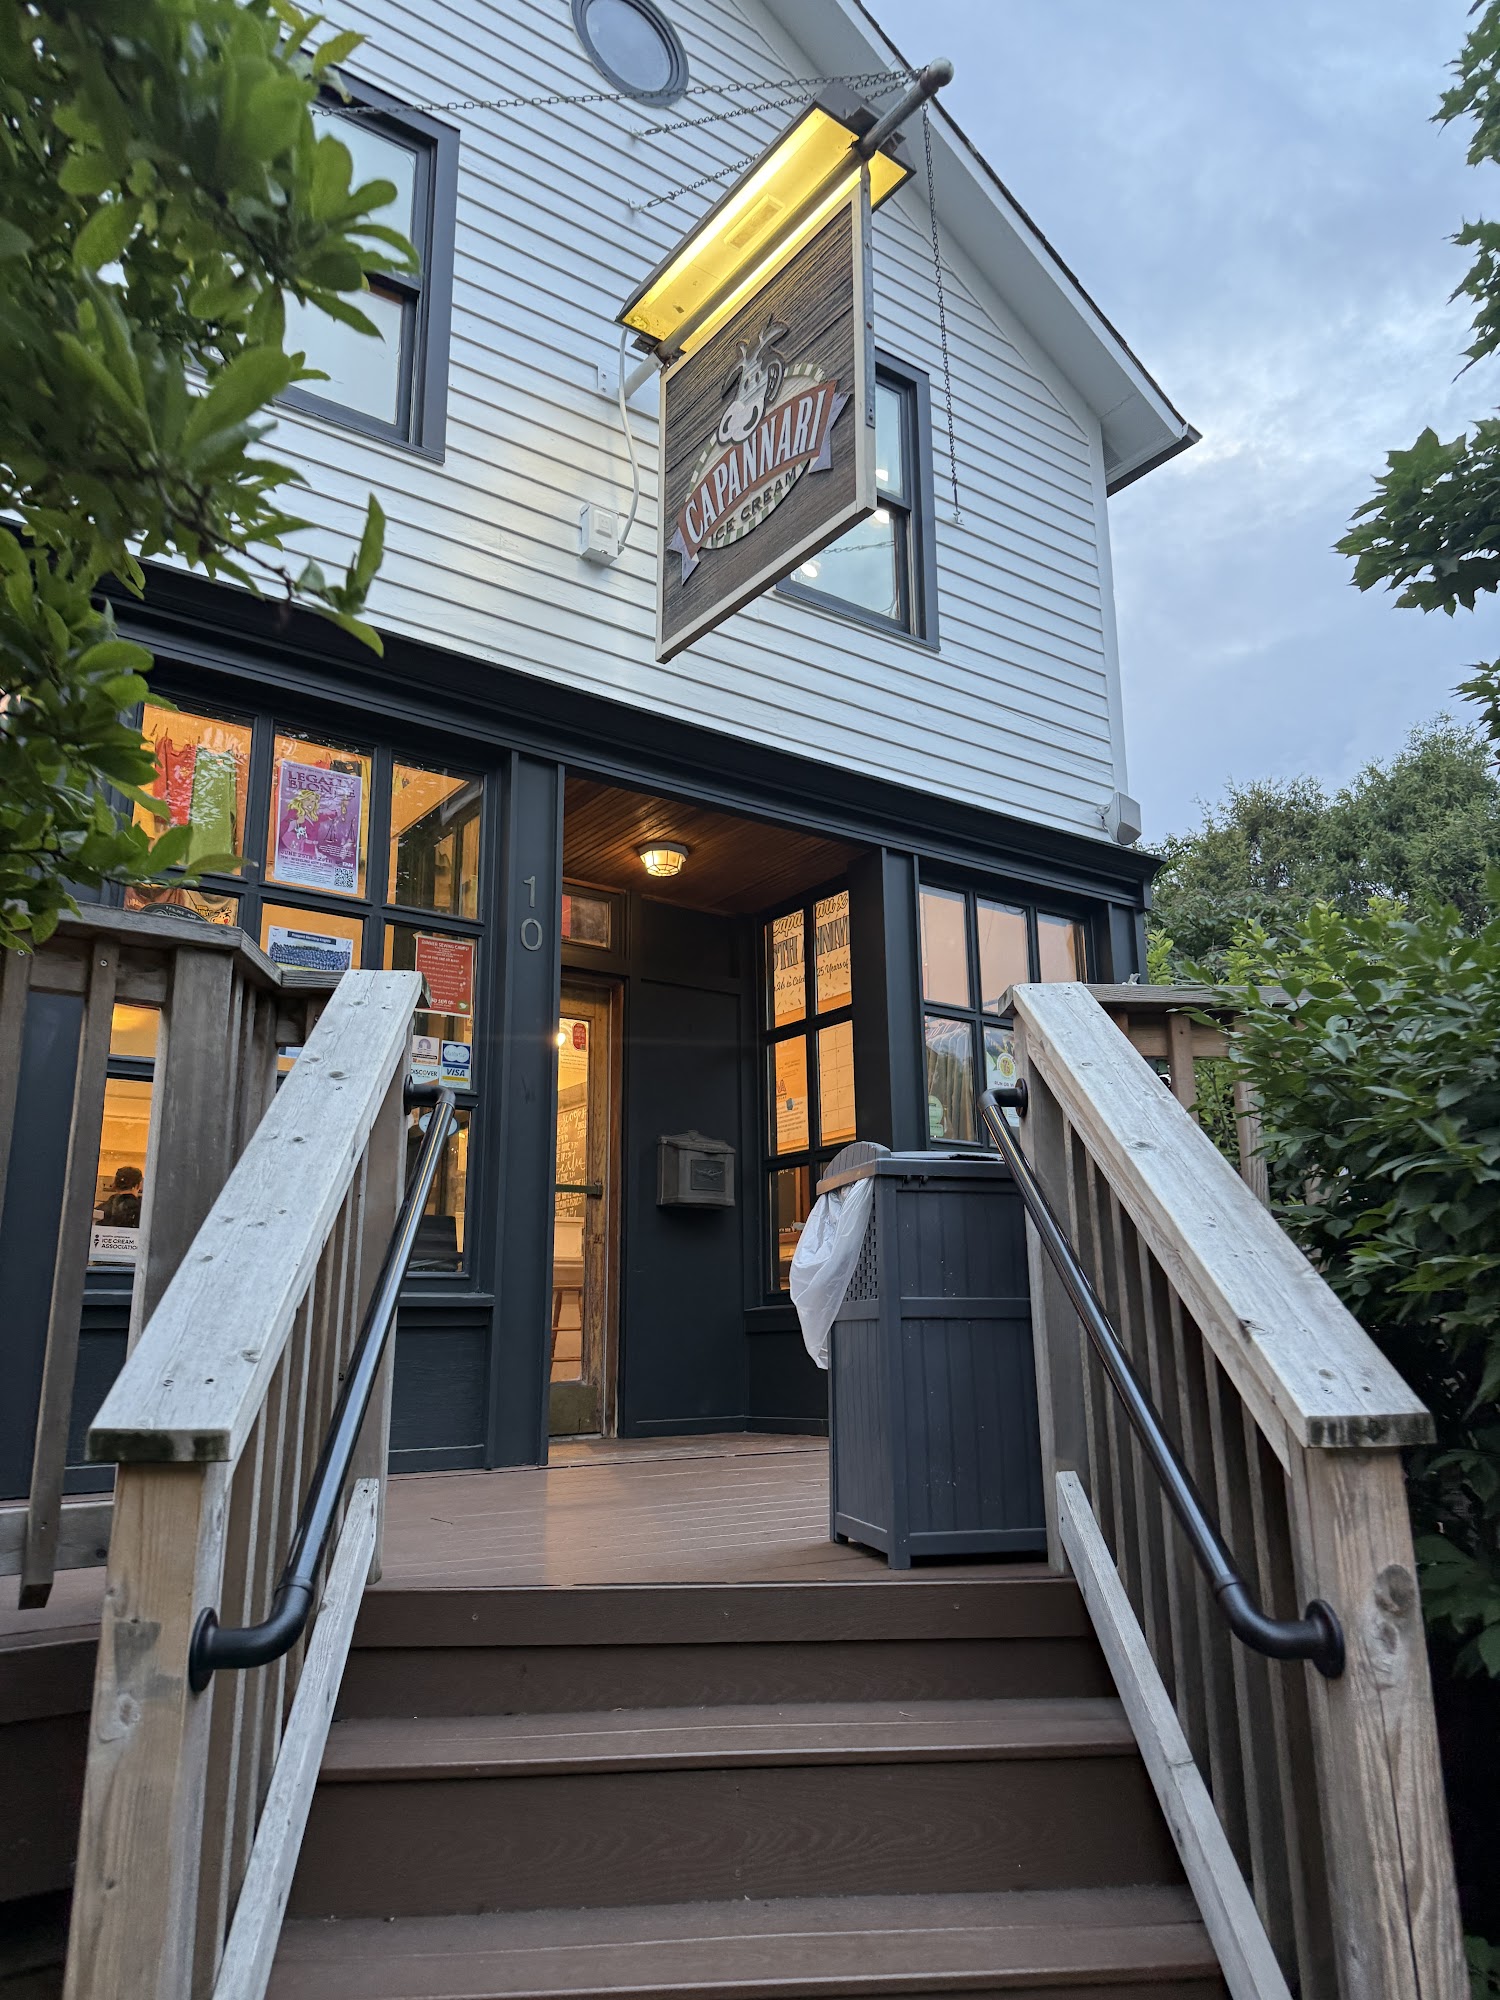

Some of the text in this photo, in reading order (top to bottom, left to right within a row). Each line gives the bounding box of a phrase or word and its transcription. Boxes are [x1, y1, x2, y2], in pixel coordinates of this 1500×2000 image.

[685, 389, 826, 543] CAPANNARI
[710, 466, 797, 547] ICE CREAM
[288, 771, 356, 788] LEGALLY
[288, 779, 356, 798] BLONDE
[411, 1069, 437, 1077] DISCOVER
[446, 1068, 465, 1076] VISA
